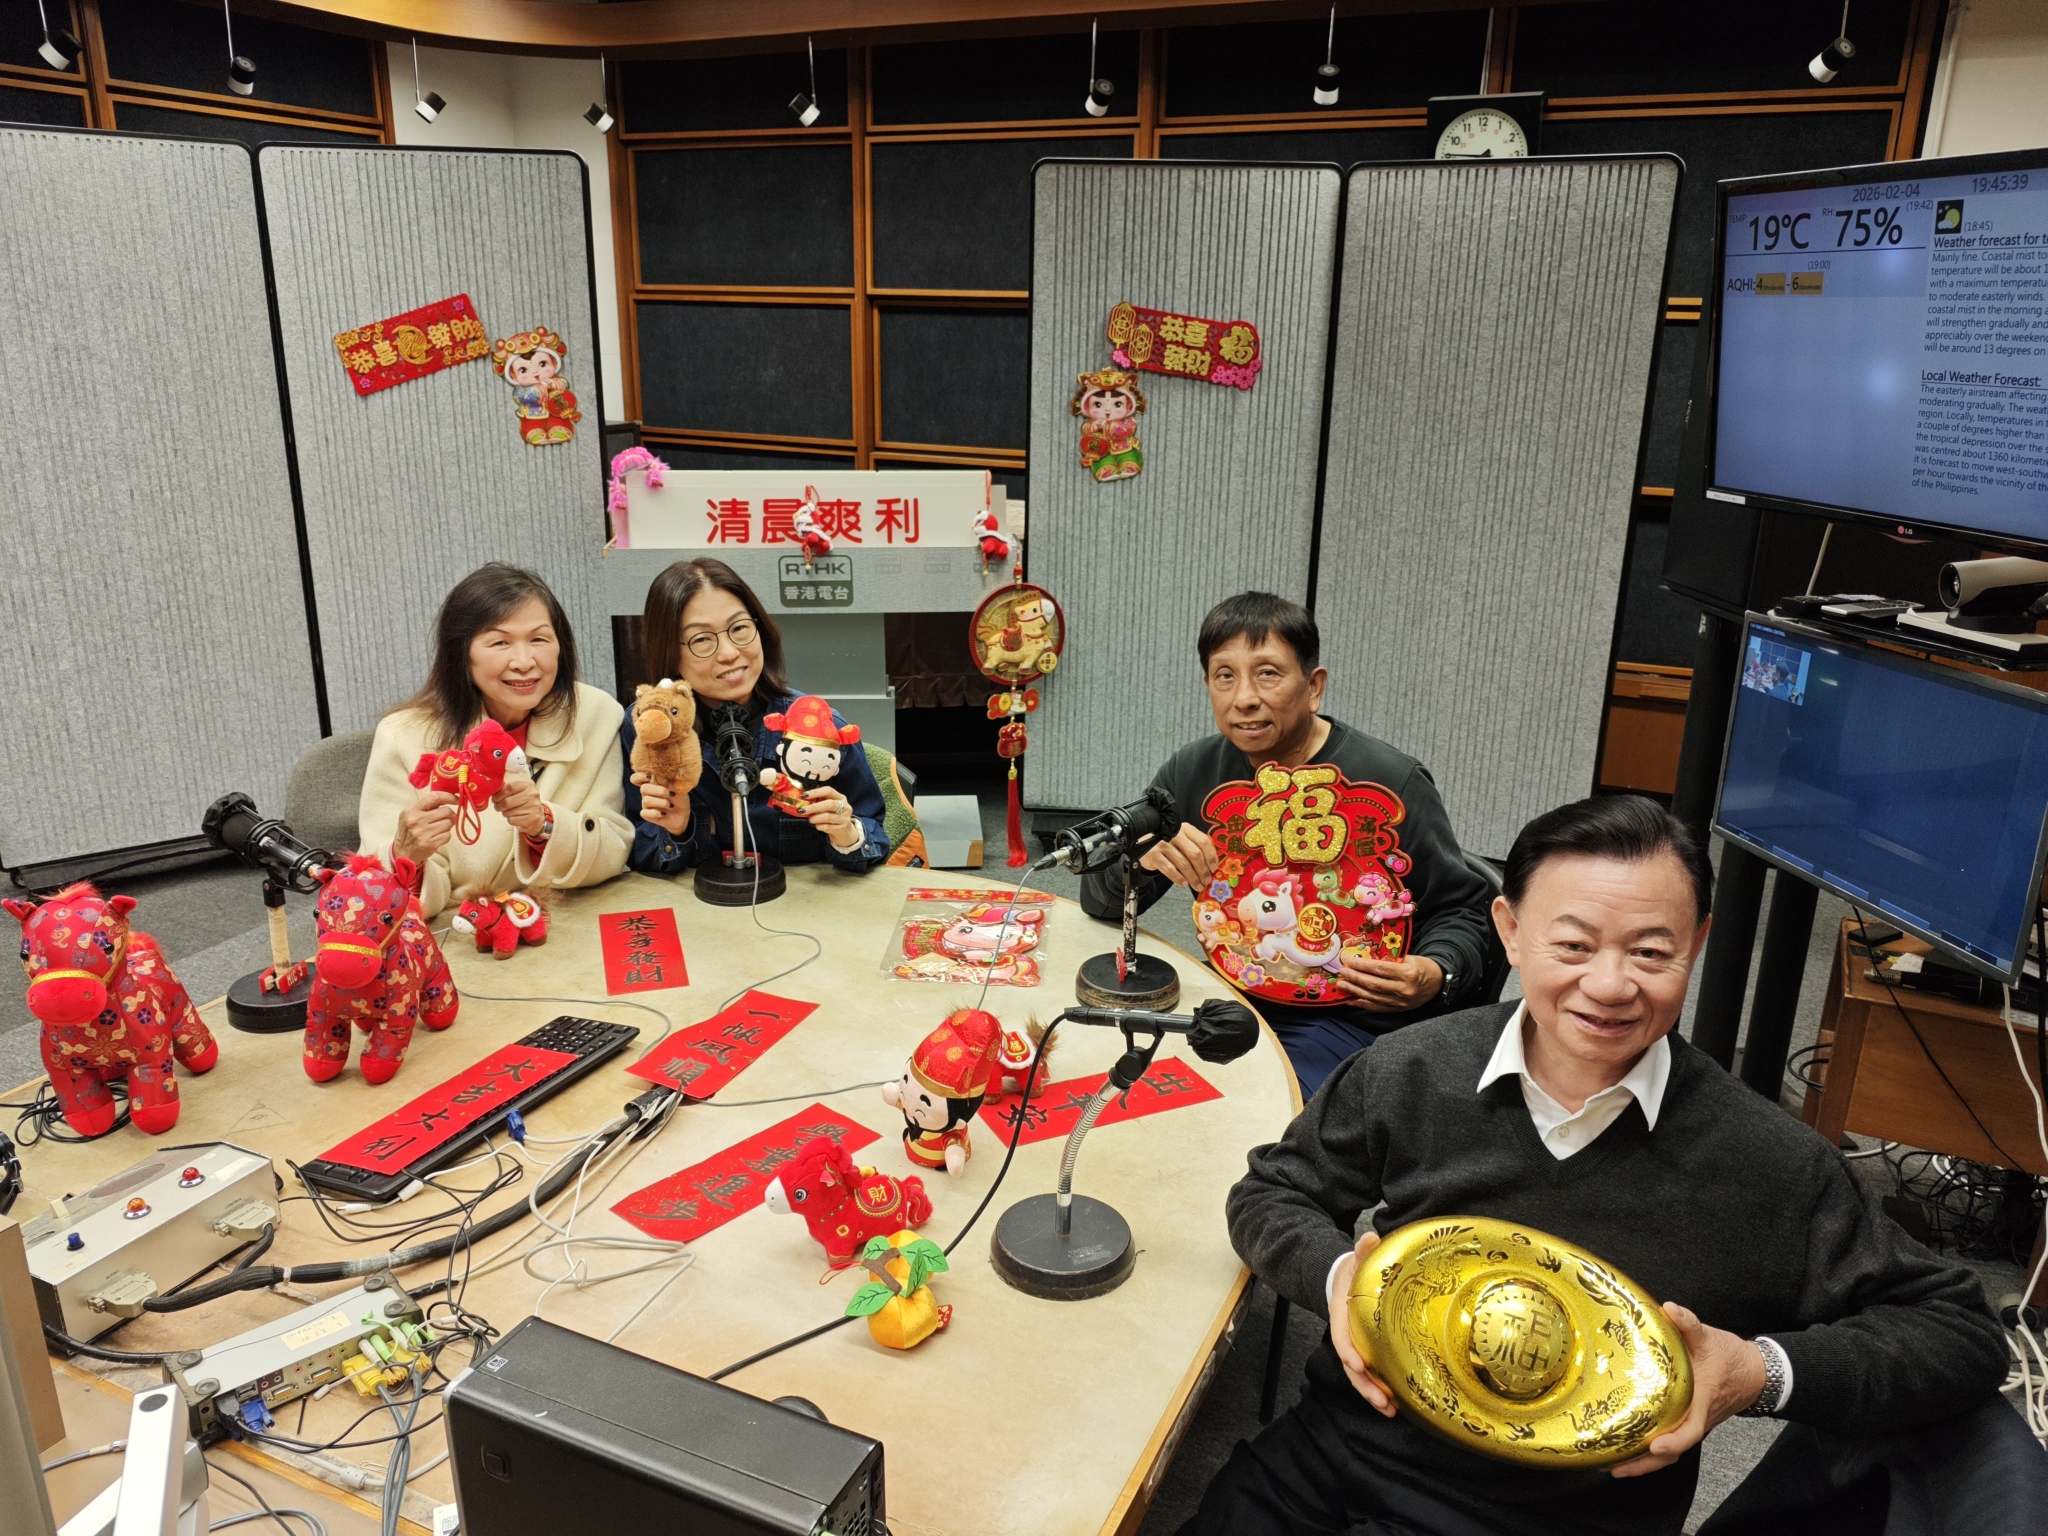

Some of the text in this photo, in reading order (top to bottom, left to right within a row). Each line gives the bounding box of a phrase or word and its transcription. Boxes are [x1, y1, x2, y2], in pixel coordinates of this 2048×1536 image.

[1463, 123, 1471, 133] 11
[1479, 116, 1488, 127] 12
[1451, 136, 1461, 146] 10
[1509, 132, 1516, 143] 2
[1973, 174, 2029, 193] 19:45:39
[1853, 183, 1920, 201] 2026-02-04
[1836, 206, 1903, 247] 75%
[1964, 221, 1993, 232] (18:45)
[1934, 236, 1976, 248] Weather
[1979, 233, 2021, 247] forecast
[2023, 232, 2040, 245] for
[1932, 253, 1960, 264] Mainly
[1981, 250, 2014, 262] Coastal
[2015, 251, 2035, 260] mist
[1931, 266, 1983, 276] temperature
[1984, 265, 1999, 274] will
[2001, 264, 2012, 274] be
[2014, 264, 2041, 274] about
[1930, 279, 1947, 288] with
[1956, 279, 1998, 288] maximum
[1929, 293, 1938, 301] to
[1940, 292, 1980, 301] moderate
[1981, 292, 2016, 304] easterly
[1928, 304, 1956, 314] coastal
[1958, 305, 1976, 314] mist
[1977, 305, 1986, 314] in
[1987, 305, 2002, 314] the
[2004, 306, 2042, 318] morning
[1926, 317, 1940, 328] will
[1941, 317, 1987, 330] strengthen
[1989, 318, 2030, 331] gradually
[1924, 331, 1973, 343] appreciably
[1974, 332, 1993, 341] over
[1995, 332, 2010, 342] the
[1924, 342, 2046, 357] will be around 13 degrees on
[1921, 369, 1947, 381] Local
[1948, 370, 1992, 384] Weather
[1920, 384, 2047, 404] The easterly airstream affecting
[1919, 396, 1965, 410] moderating
[2008, 402, 2024, 413] The
[1977, 413, 2034, 427] temperatures
[2035, 417, 2044, 427] in
[1923, 421, 1950, 432] couple
[1951, 422, 1960, 432] of
[1961, 424, 1994, 436] degrees
[1995, 425, 2024, 440] higher
[2025, 428, 2045, 440] than
[1916, 431, 1929, 441] the
[1930, 433, 1960, 446] tropical
[1961, 436, 2006, 450] depression
[2007, 442, 2027, 451] over
[2028, 442, 2044, 453] the
[1915, 445, 1930, 453] was
[1931, 446, 1961, 457] centred
[1962, 448, 1986, 460] about
[1988, 450, 2009, 461] 1360
[1928, 456, 1959, 468] forecast
[1961, 460, 1970, 469] to
[1971, 463, 1995, 473] move
[1911, 478, 1920, 487] of
[1920, 479, 1934, 489] the
[1912, 467, 1925, 477] per
[1927, 468, 1946, 479] hour
[1947, 471, 1978, 483] towards
[1980, 474, 1994, 485] the
[1995, 477, 2025, 491] vicinity
[2026, 481, 2037, 491] of
[706, 497, 920, 545] 清晨爽利
[785, 562, 846, 576] RTHK
[784, 585, 849, 601] 香港電台
[1243, 765, 1348, 866] 福
[659, 1008, 782, 1086] 一帆風順
[360, 1057, 536, 1161] 大吉大利
[867, 1183, 888, 1206] 財
